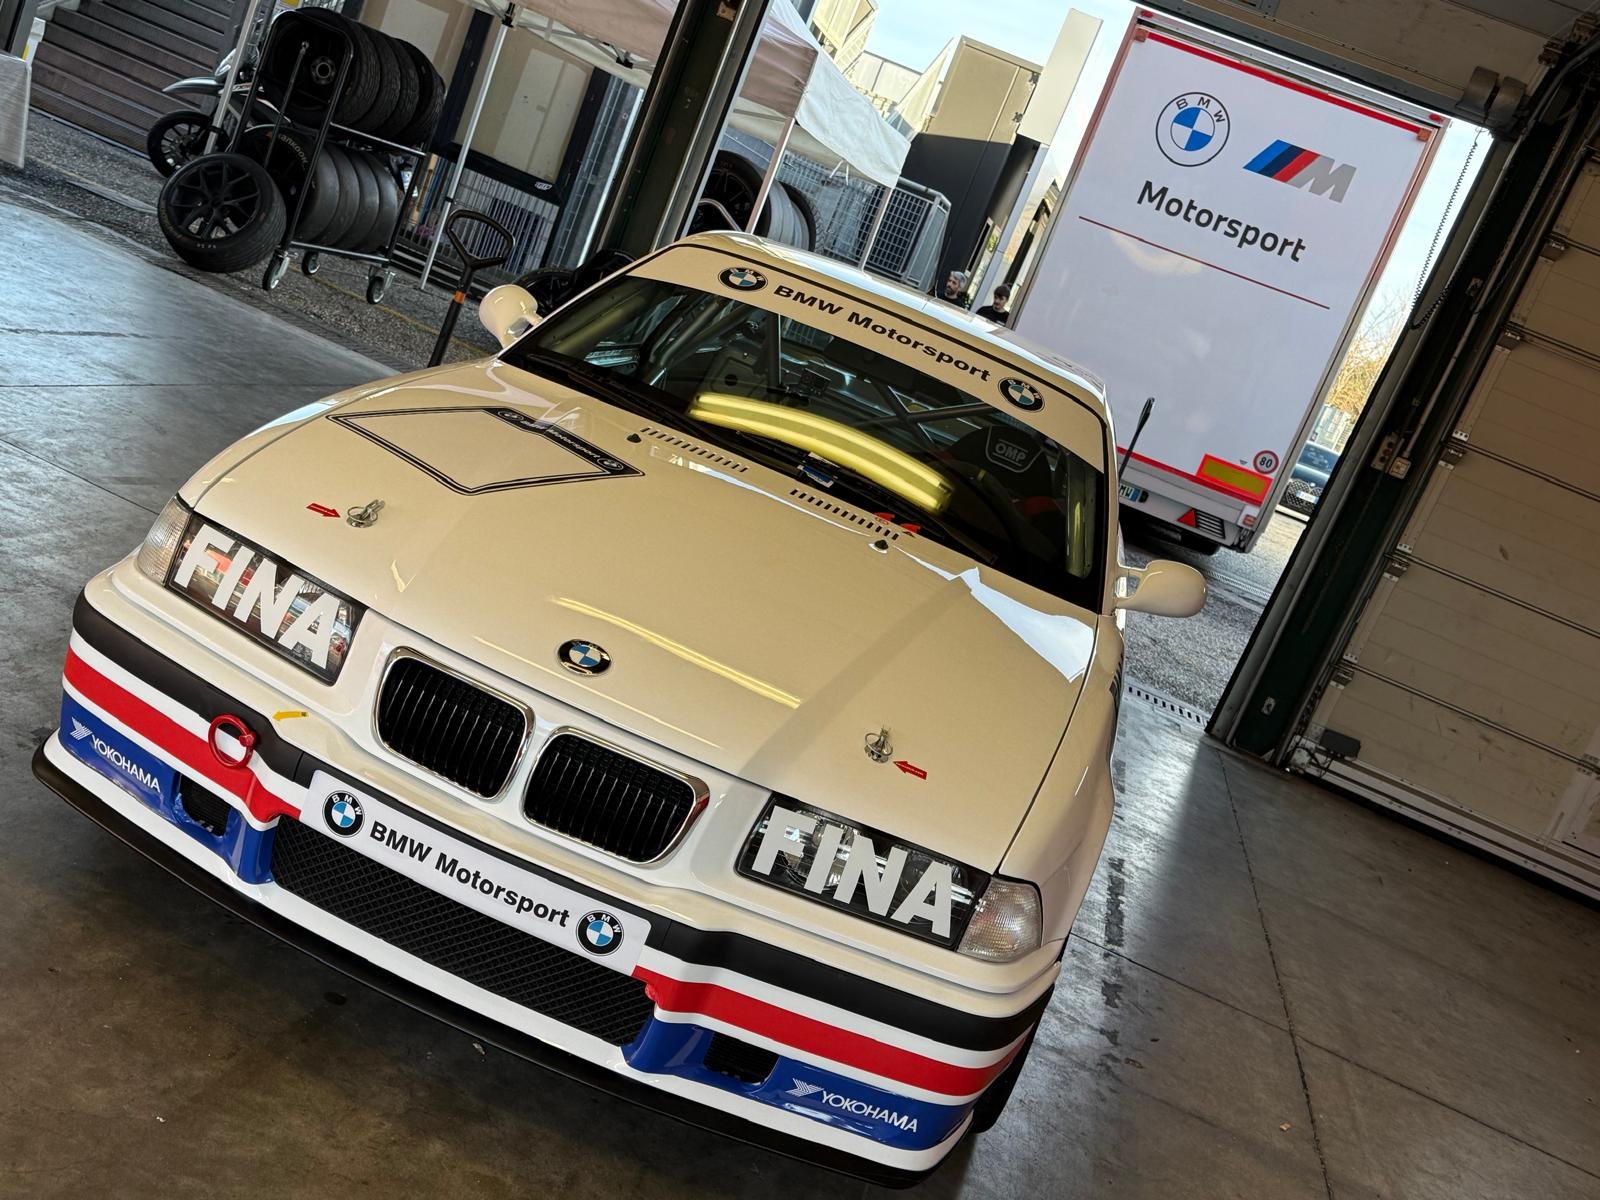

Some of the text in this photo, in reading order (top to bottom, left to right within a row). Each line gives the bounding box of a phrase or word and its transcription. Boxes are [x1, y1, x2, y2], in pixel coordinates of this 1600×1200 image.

[1137, 180, 1306, 263] Motorsport
[773, 285, 991, 382] BMW Motorsport
[995, 443, 1027, 463] OMP
[174, 523, 340, 670] FINA
[91, 734, 161, 793] YOKOHAMA
[369, 820, 570, 928] BMW Motorsport
[751, 805, 952, 939] FINA
[822, 1090, 918, 1133] YOKOHAMA
